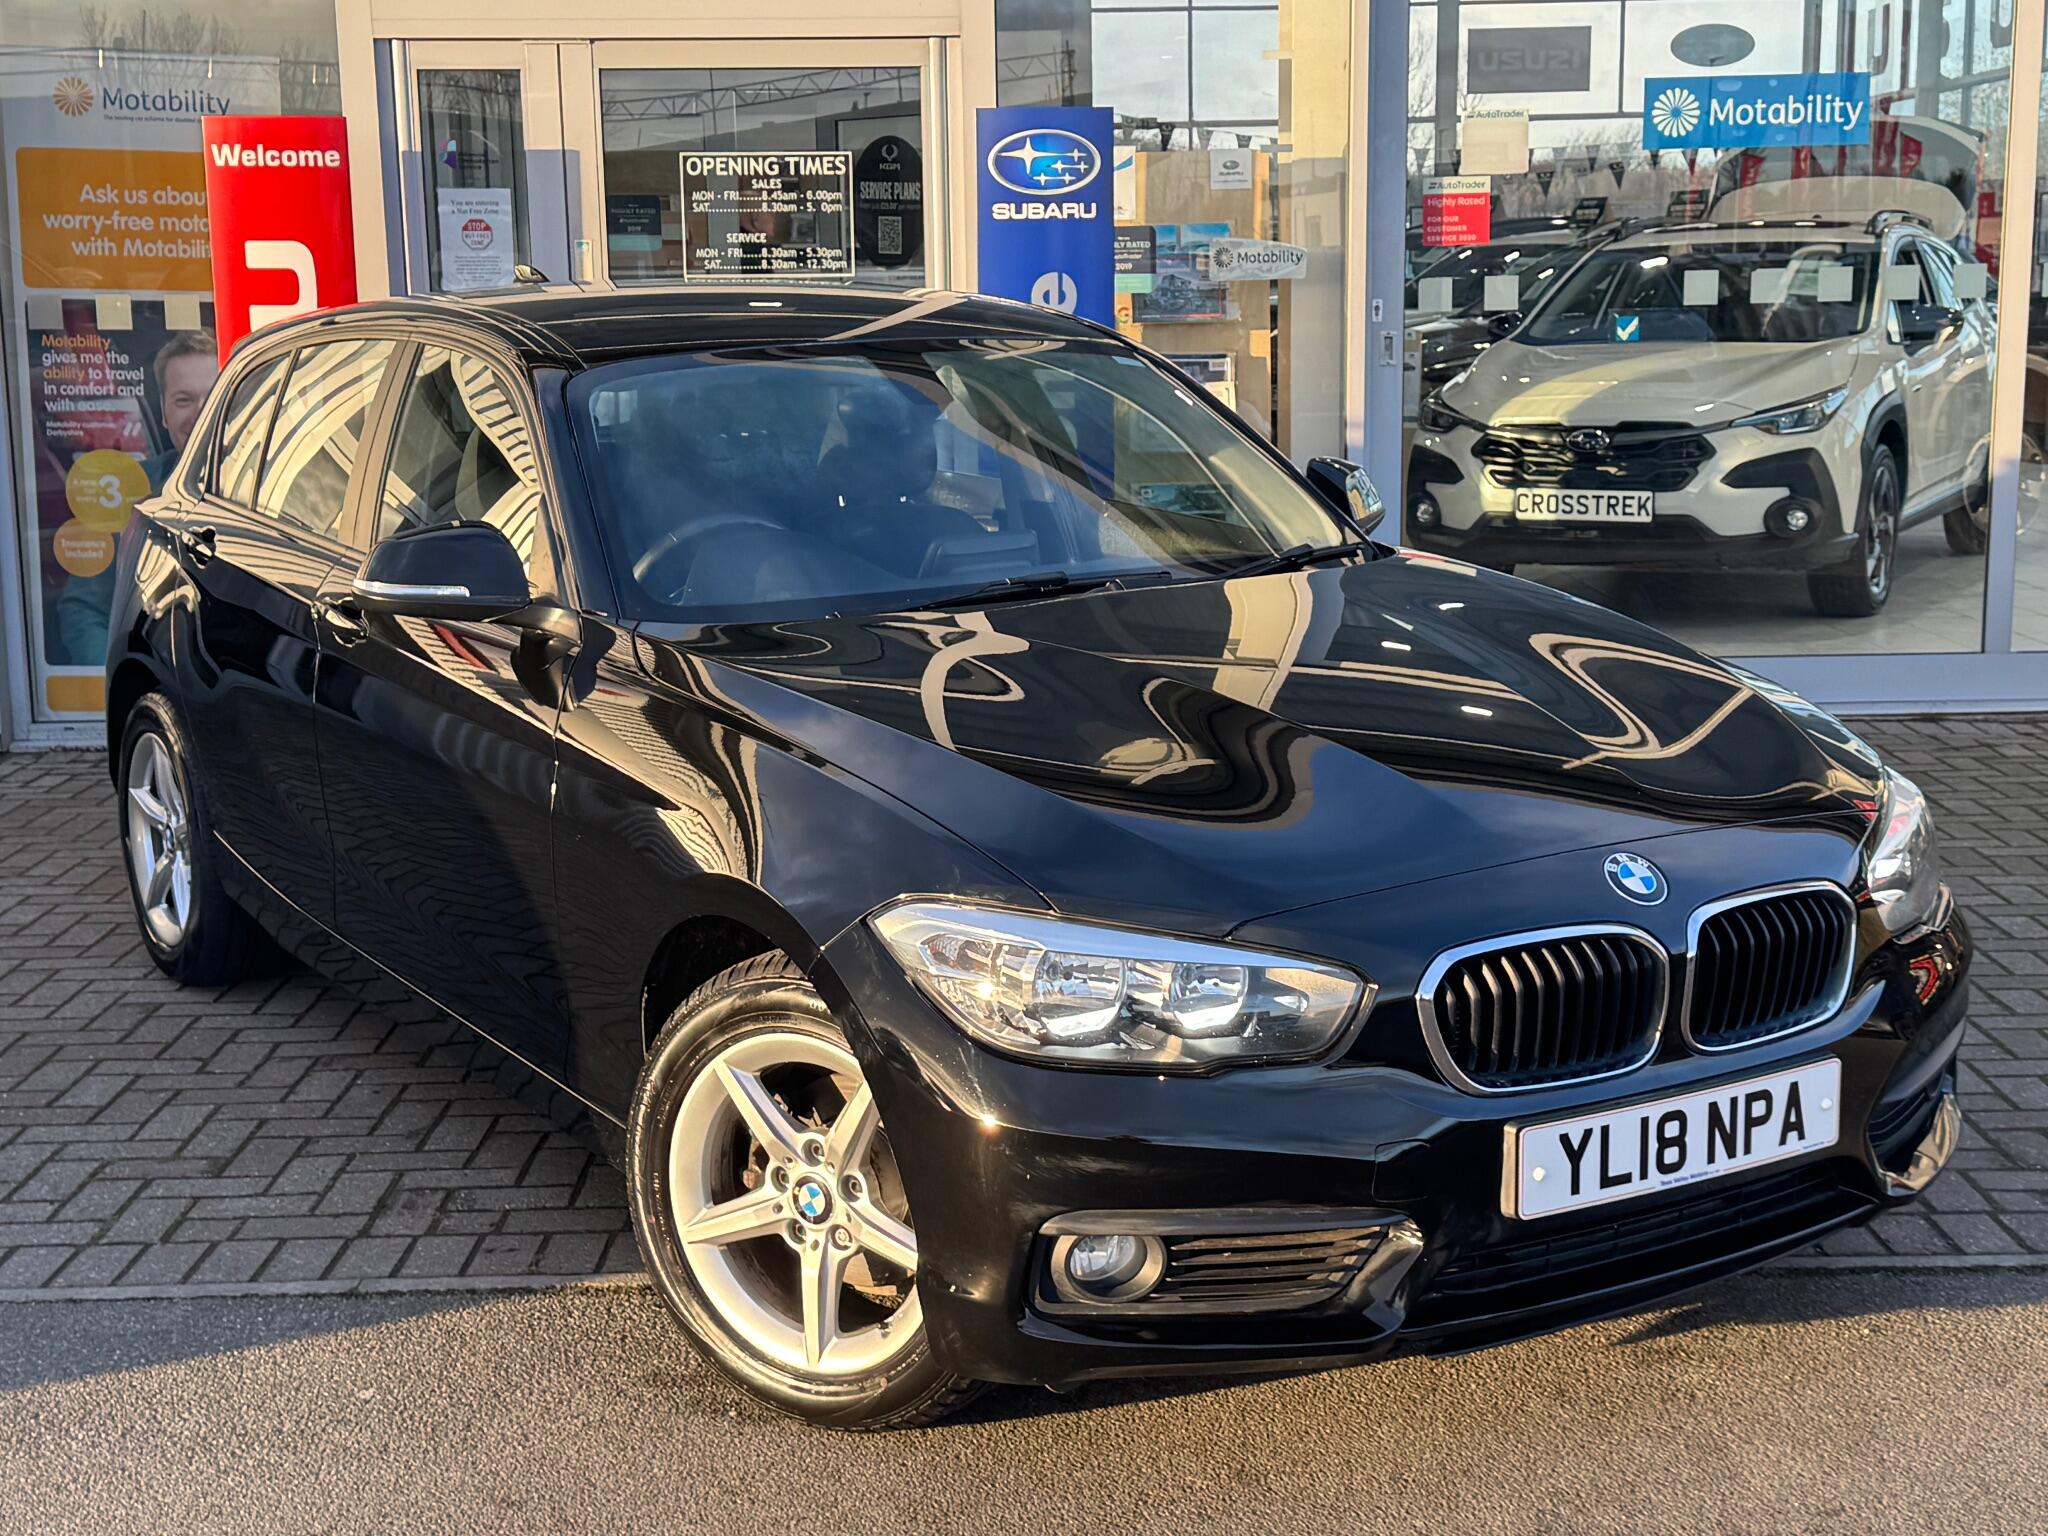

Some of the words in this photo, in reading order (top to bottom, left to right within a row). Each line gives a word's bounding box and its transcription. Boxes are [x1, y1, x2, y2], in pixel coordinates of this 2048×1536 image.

[102, 87, 231, 115] Motability
[1475, 110, 1525, 119] AutoTrader
[1709, 94, 1864, 131] Motability
[210, 143, 341, 168] Welcome
[686, 156, 780, 176] OPENING
[784, 156, 847, 176] TIMES
[751, 178, 782, 189] SALES
[860, 181, 892, 200] SERVICE
[894, 182, 921, 200] PLANS
[1437, 181, 1486, 189] AutoTrader
[79, 183, 119, 203] Ask
[124, 188, 148, 205] us
[153, 185, 206, 206] abou
[692, 190, 715, 201] MON
[1427, 197, 1457, 208] Highly
[1457, 196, 1485, 205] Rated
[992, 202, 1097, 220] SUBARU
[43, 211, 154, 235] worry-free
[160, 214, 209, 233] moto
[467, 222, 487, 231] STOP
[726, 232, 767, 244] SERVICE
[71, 236, 118, 257] with
[123, 237, 211, 259] Motabili
[696, 248, 719, 258] MON
[806, 247, 842, 259] 5.30pm
[806, 259, 848, 271] 12.30pm
[1237, 250, 1304, 266] Motability
[42, 334, 111, 351] Motability
[42, 350, 78, 366] gives
[80, 352, 103, 364] me
[106, 351, 130, 365] the
[43, 366, 85, 382] ability
[88, 367, 102, 380] to
[105, 367, 145, 380] travel
[44, 381, 57, 395] in
[60, 382, 114, 396] comfort
[117, 383, 145, 397] and
[44, 398, 75, 412] with
[99, 474, 122, 509] 3
[1517, 493, 1650, 517] CROSSTREK
[1558, 1108, 1688, 1196] YL18
[1707, 1081, 1806, 1166] NPA
